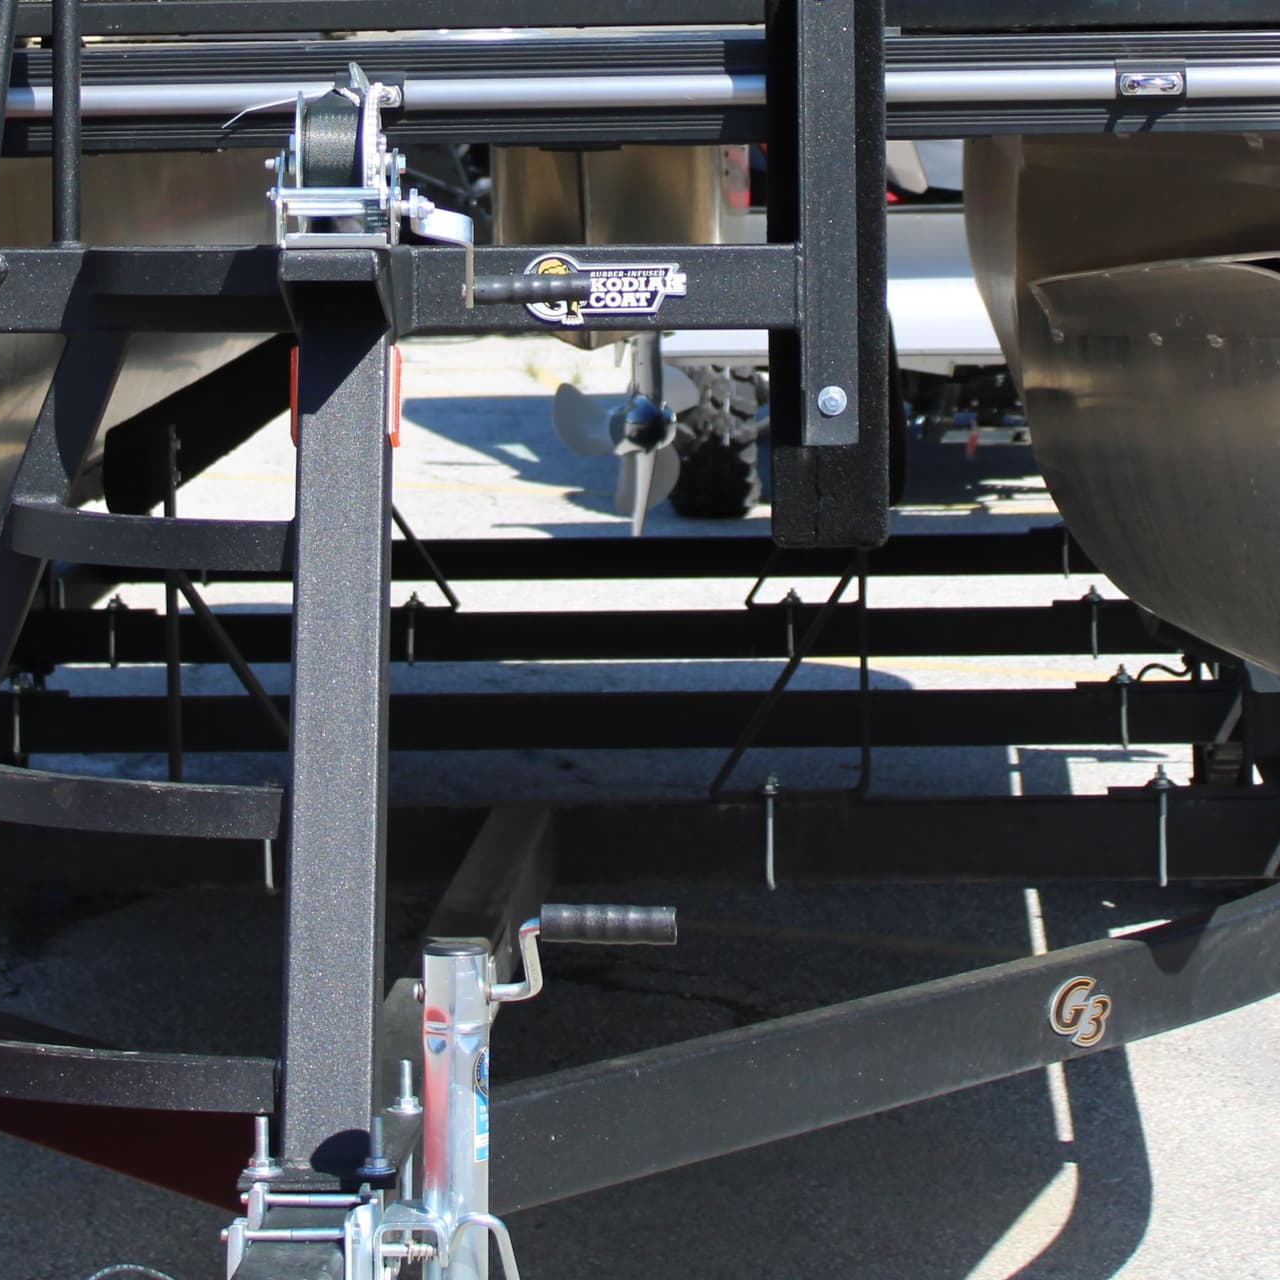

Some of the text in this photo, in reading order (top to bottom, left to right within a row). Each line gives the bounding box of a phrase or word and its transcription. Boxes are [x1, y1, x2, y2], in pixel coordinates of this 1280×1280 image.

[590, 274, 687, 293] KODIAK
[589, 291, 651, 308] COAT
[1050, 975, 1112, 1047] G3
